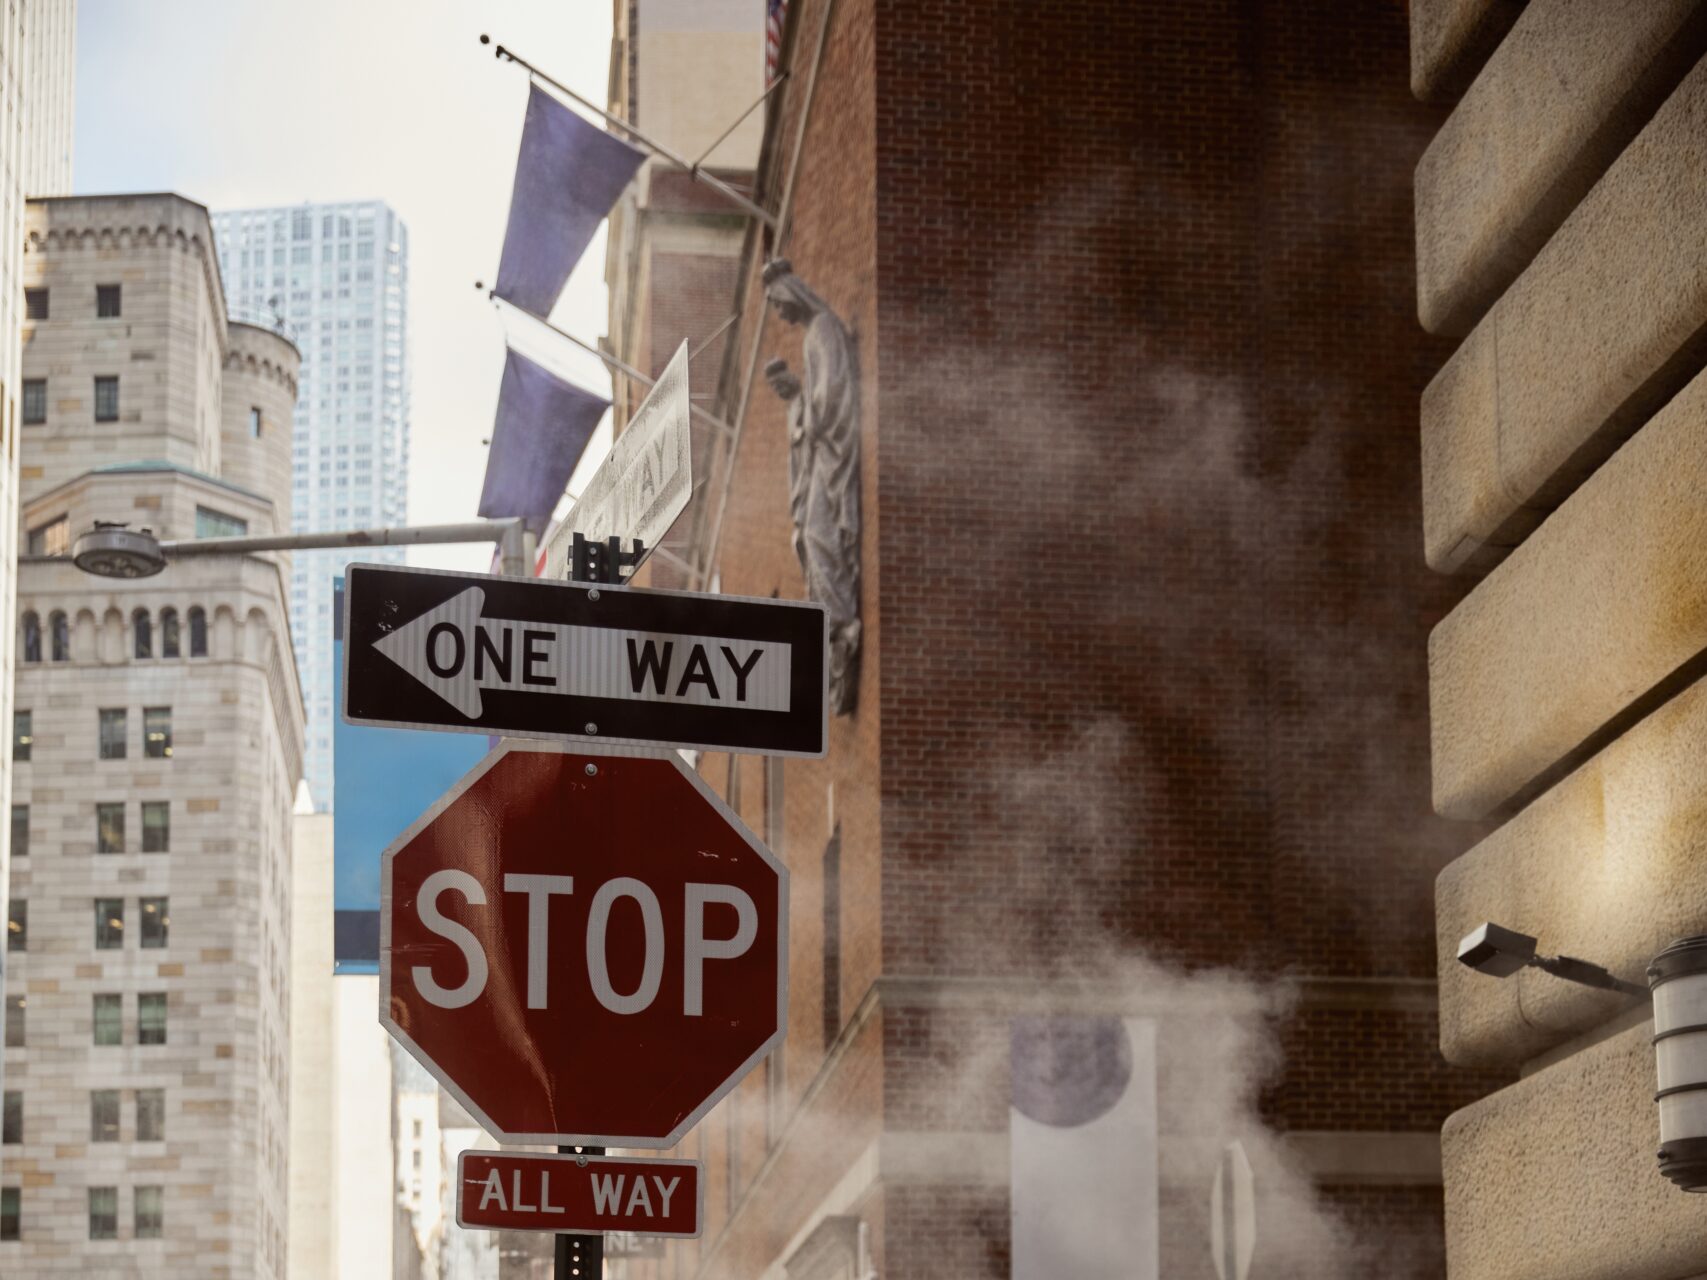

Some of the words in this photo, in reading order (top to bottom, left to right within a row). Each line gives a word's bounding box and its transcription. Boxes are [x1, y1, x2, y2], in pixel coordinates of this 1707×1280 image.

[425, 622, 557, 687] ONE
[626, 638, 764, 702] WAY
[411, 868, 758, 1016] STOP
[479, 1168, 565, 1214] ALL
[591, 1174, 681, 1218] WAY
